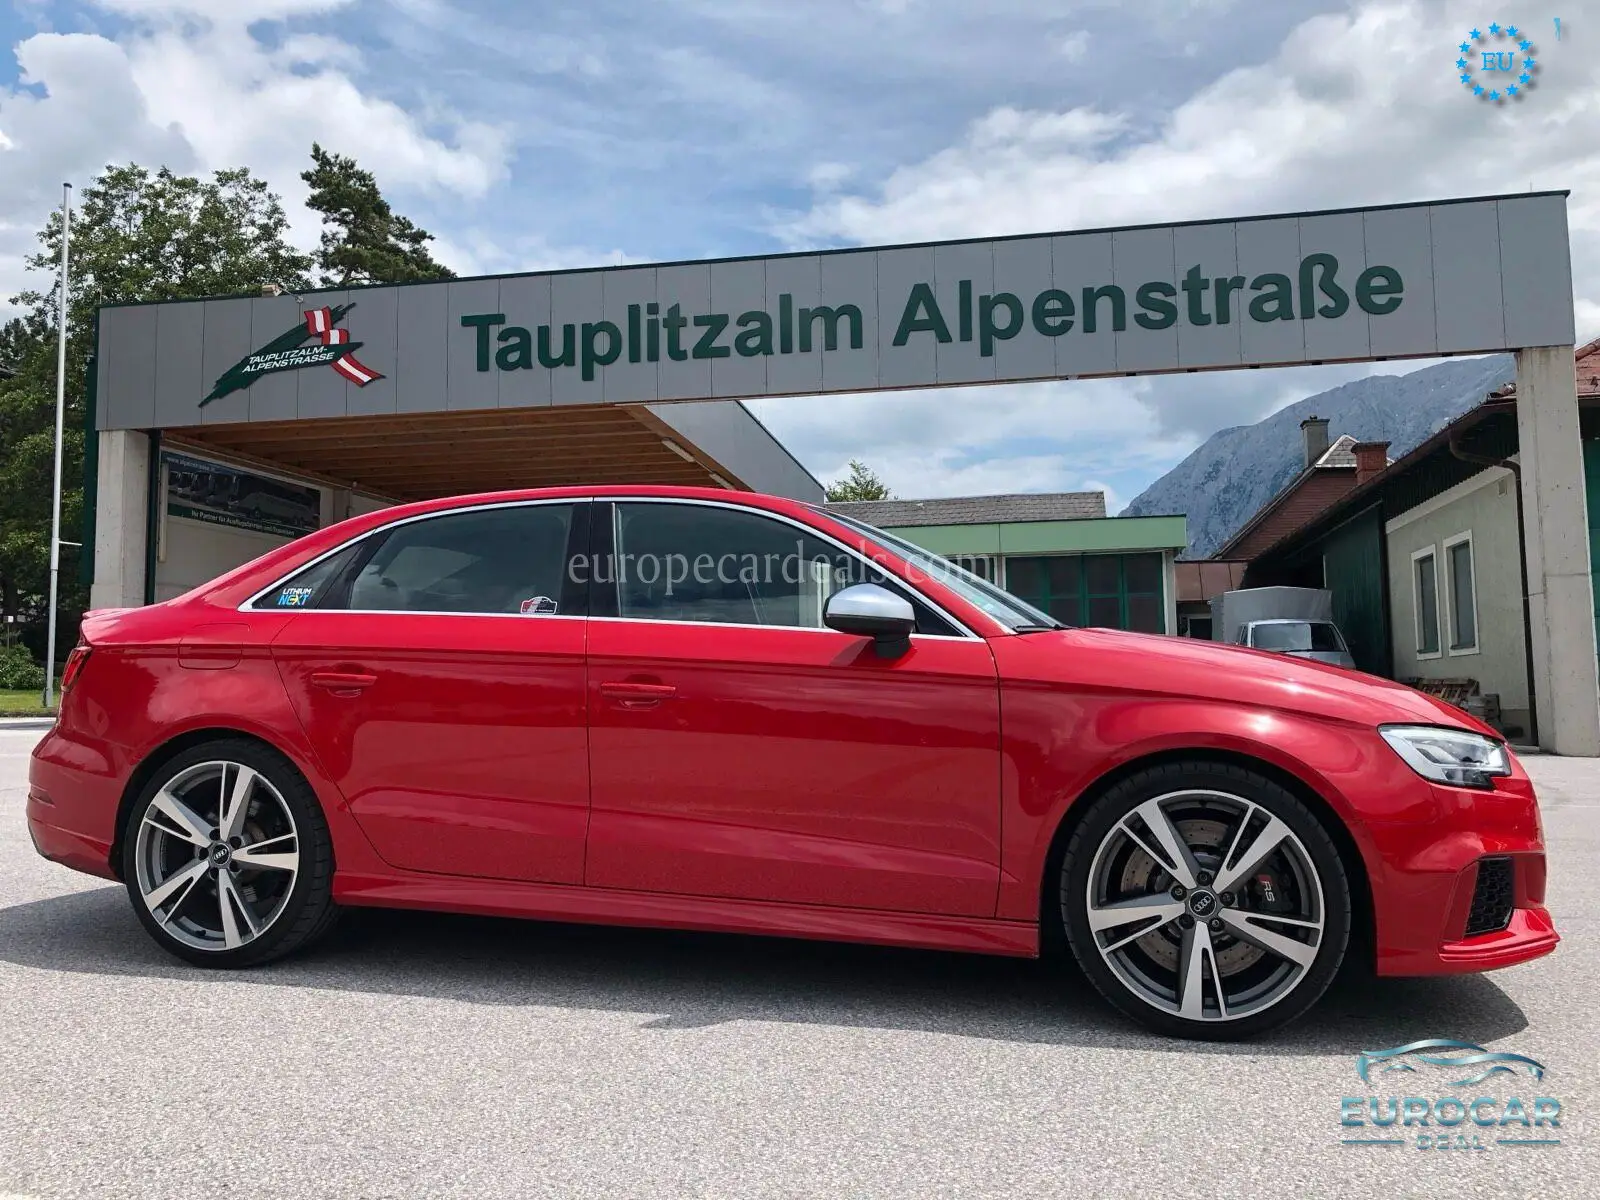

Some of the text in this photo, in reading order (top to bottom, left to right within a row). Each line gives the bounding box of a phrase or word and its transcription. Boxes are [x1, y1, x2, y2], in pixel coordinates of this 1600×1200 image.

[461, 252, 1404, 381] Tauplitzalm Alpenstraße
[241, 352, 335, 374] ALPENSTRASSE
[249, 346, 328, 364] TAUPLITZALM-
[278, 594, 309, 606] NEXT
[283, 587, 312, 595] LITHIUM
